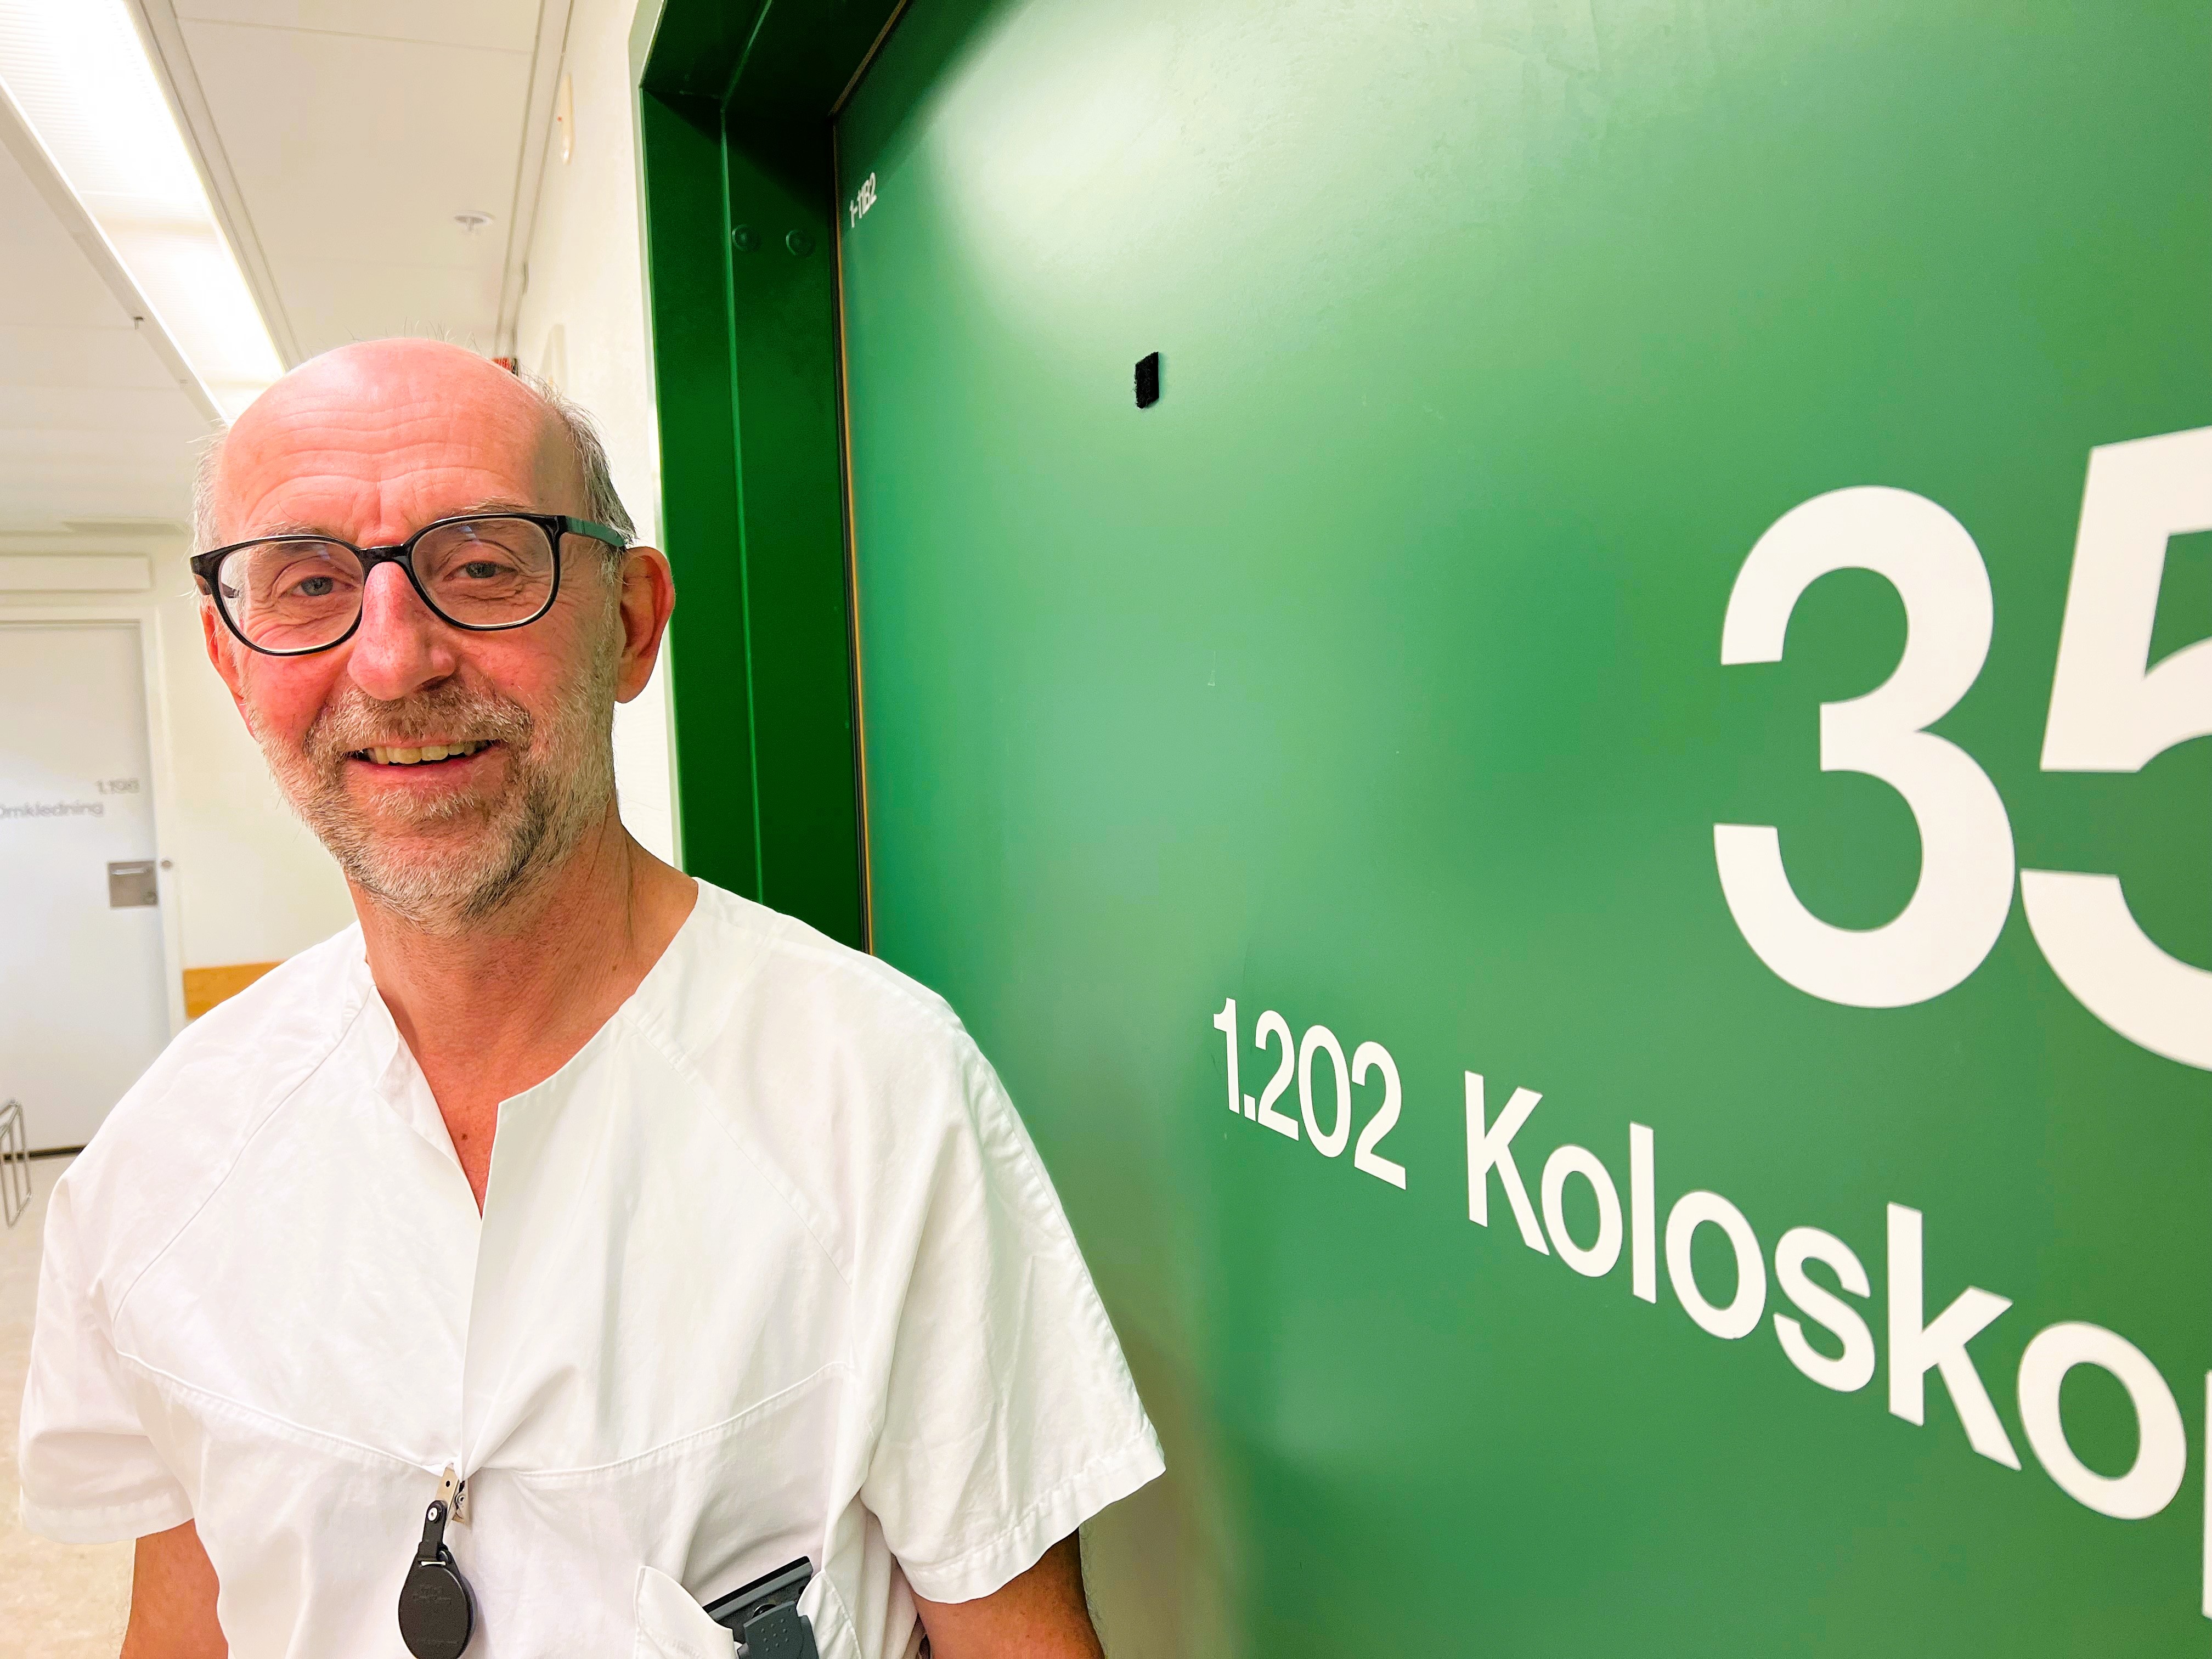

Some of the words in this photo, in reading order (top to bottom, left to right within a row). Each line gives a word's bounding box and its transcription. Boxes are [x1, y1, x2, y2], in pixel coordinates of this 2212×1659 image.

[1713, 425, 2212, 1073] 35
[1212, 996, 1407, 1191] 1.202
[1464, 1069, 2212, 1620] Kolosko
